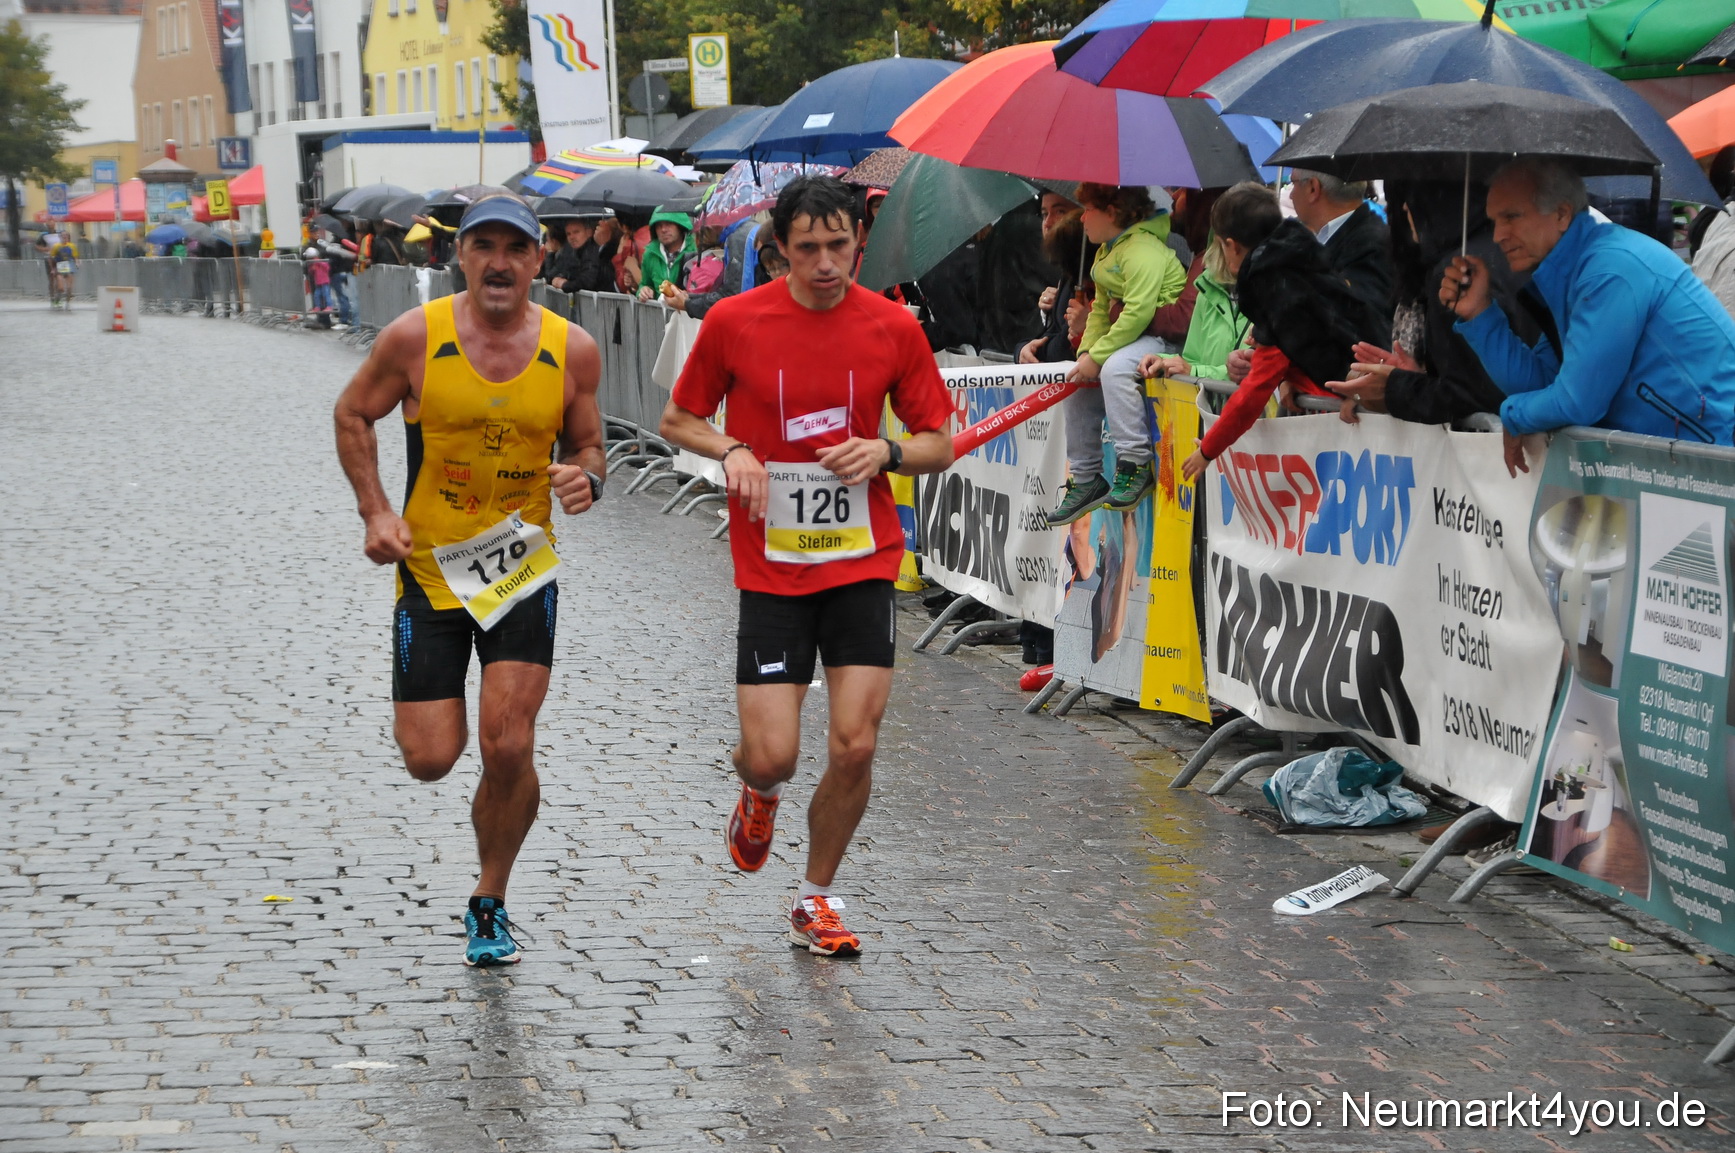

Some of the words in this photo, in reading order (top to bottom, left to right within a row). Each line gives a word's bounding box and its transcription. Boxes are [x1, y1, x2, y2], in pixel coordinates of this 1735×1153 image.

[49, 205, 68, 213] TAXI
[213, 190, 225, 207] D
[803, 416, 829, 431] DEHN
[976, 416, 1003, 437] Audi
[1005, 401, 1030, 420] BKK
[444, 465, 471, 480] Seidl
[768, 472, 803, 482] PARTL
[789, 485, 850, 524] 126
[798, 534, 842, 549] Stefan
[438, 548, 474, 565] PARTL
[1015, 556, 1048, 583] 92318
[494, 564, 536, 599] Robert
[1646, 576, 1679, 606] MATHI
[1682, 584, 1723, 617] HOFFER
[1687, 618, 1722, 640] TROCKENBAU
[1458, 621, 1492, 671] Stadt
[1663, 631, 1702, 652] FASSADENBAU
[1639, 685, 1663, 708] 92318
[1663, 691, 1697, 718] Neumarkt
[1654, 781, 1700, 814] Trockenbau
